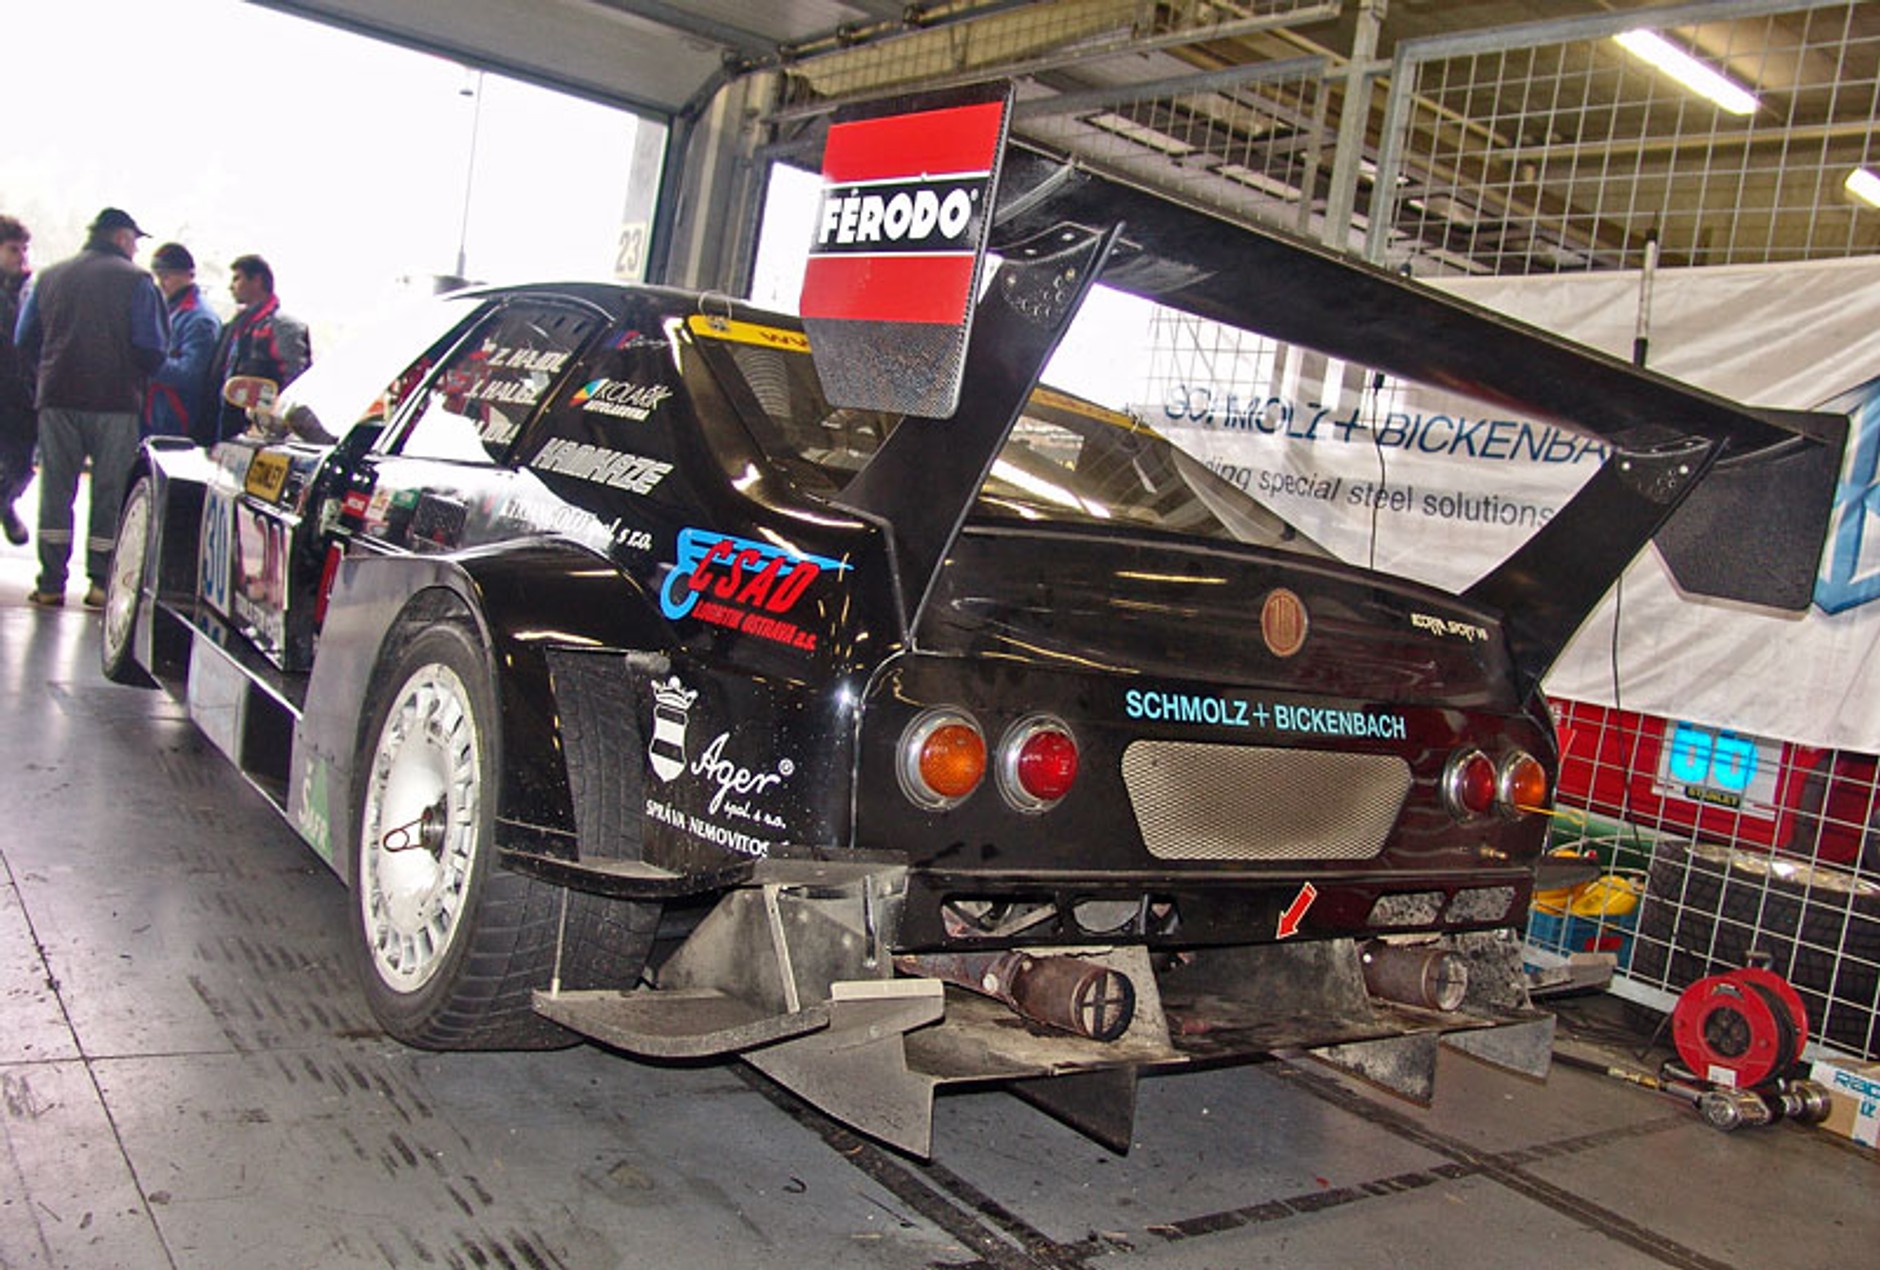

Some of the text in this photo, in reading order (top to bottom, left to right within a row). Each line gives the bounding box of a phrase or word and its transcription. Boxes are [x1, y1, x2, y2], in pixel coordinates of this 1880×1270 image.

[614, 227, 644, 273] 23
[1377, 413, 1609, 465] BICKENBA
[1203, 456, 1554, 530] ding special steel solutions
[1125, 689, 1407, 740] SCHMOLZ + BICKENBACH
[646, 799, 770, 859] SPRÁVA NEMOVITOS
